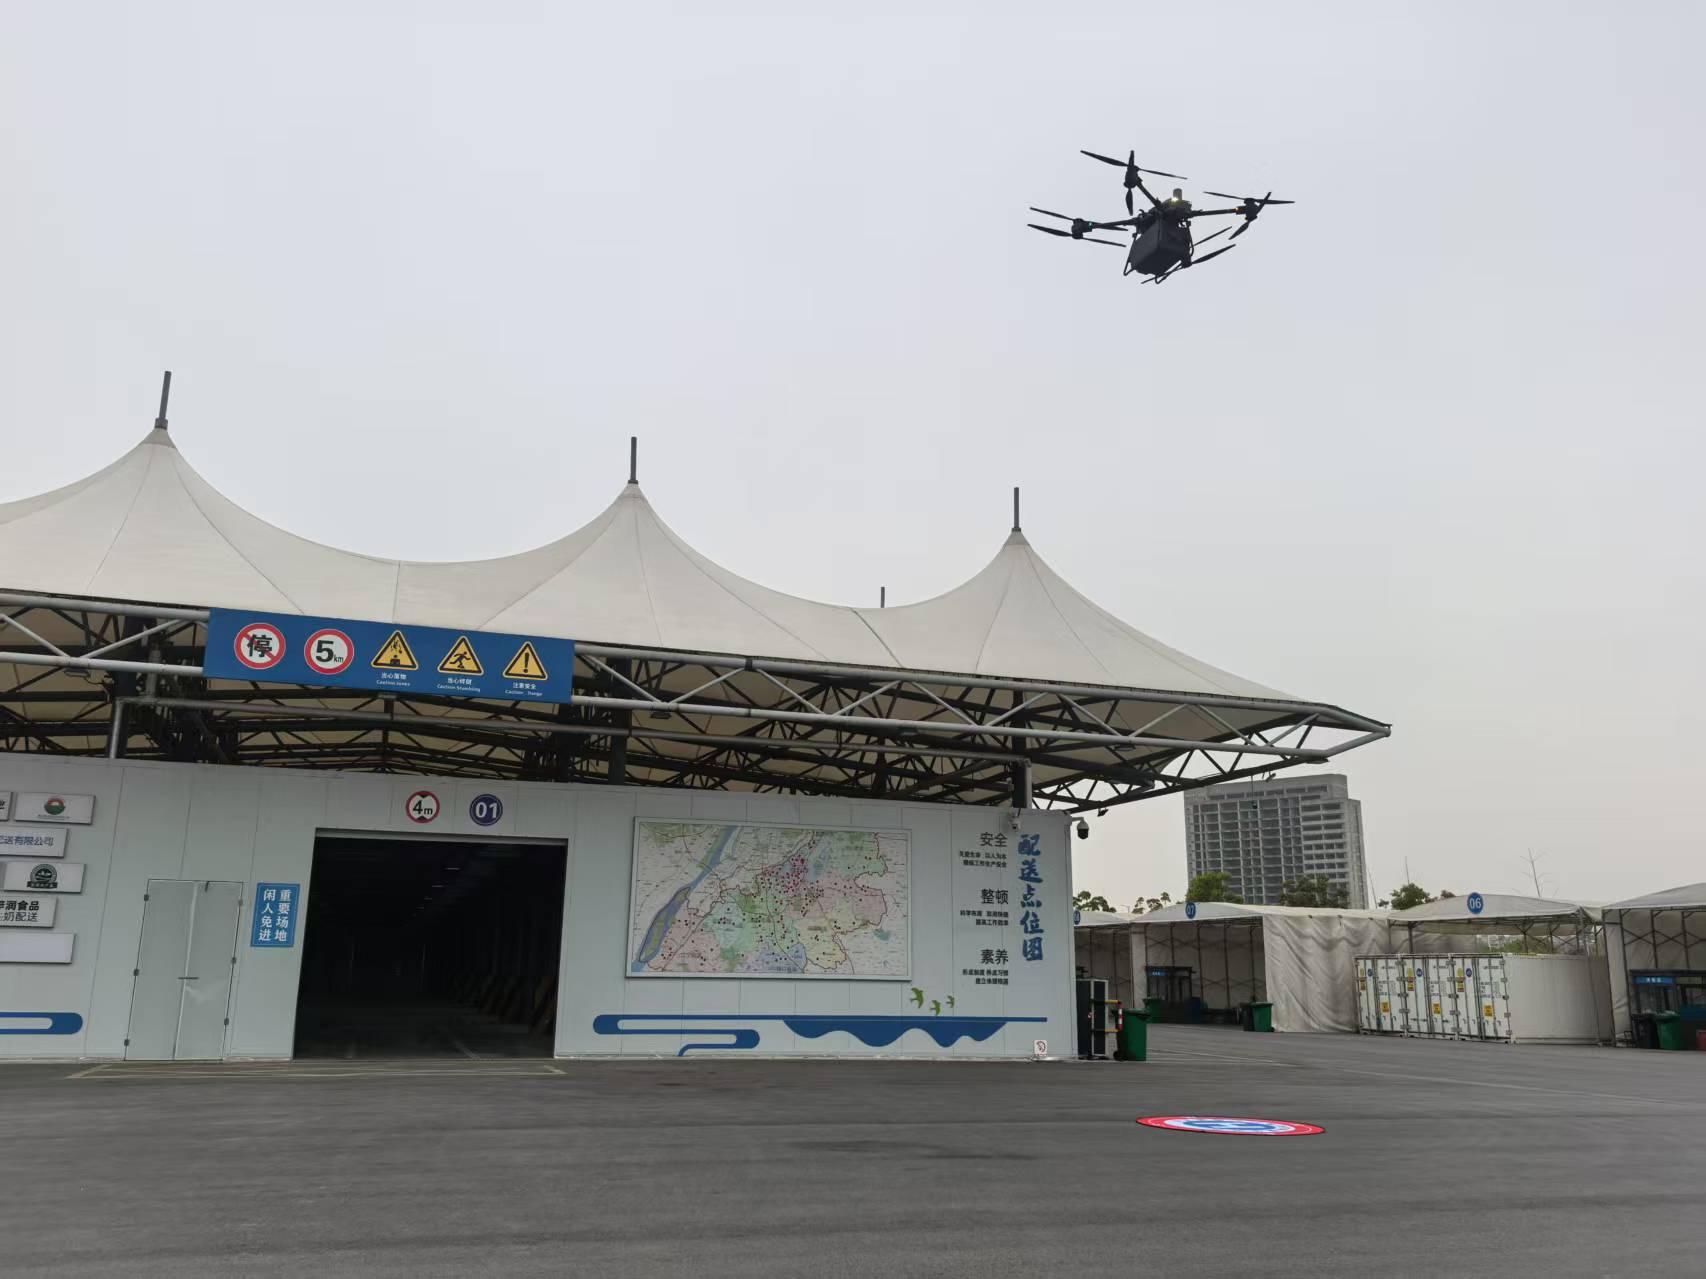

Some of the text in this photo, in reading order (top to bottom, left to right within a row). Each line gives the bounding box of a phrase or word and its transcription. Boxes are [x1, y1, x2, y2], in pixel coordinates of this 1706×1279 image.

[247, 634, 272, 657] 停
[413, 799, 434, 815] 4m
[475, 801, 498, 819] 01
[0, 836, 54, 847] 送有限公司
[980, 831, 1008, 848] 安全
[980, 888, 1008, 905] 整顿
[1018, 834, 1044, 961] 配送点位图
[1470, 896, 1481, 910] 06
[259, 888, 276, 942] 闲人免进
[275, 889, 292, 942] 重要场地
[1186, 904, 1195, 916] 07
[980, 948, 1009, 965] 素养
